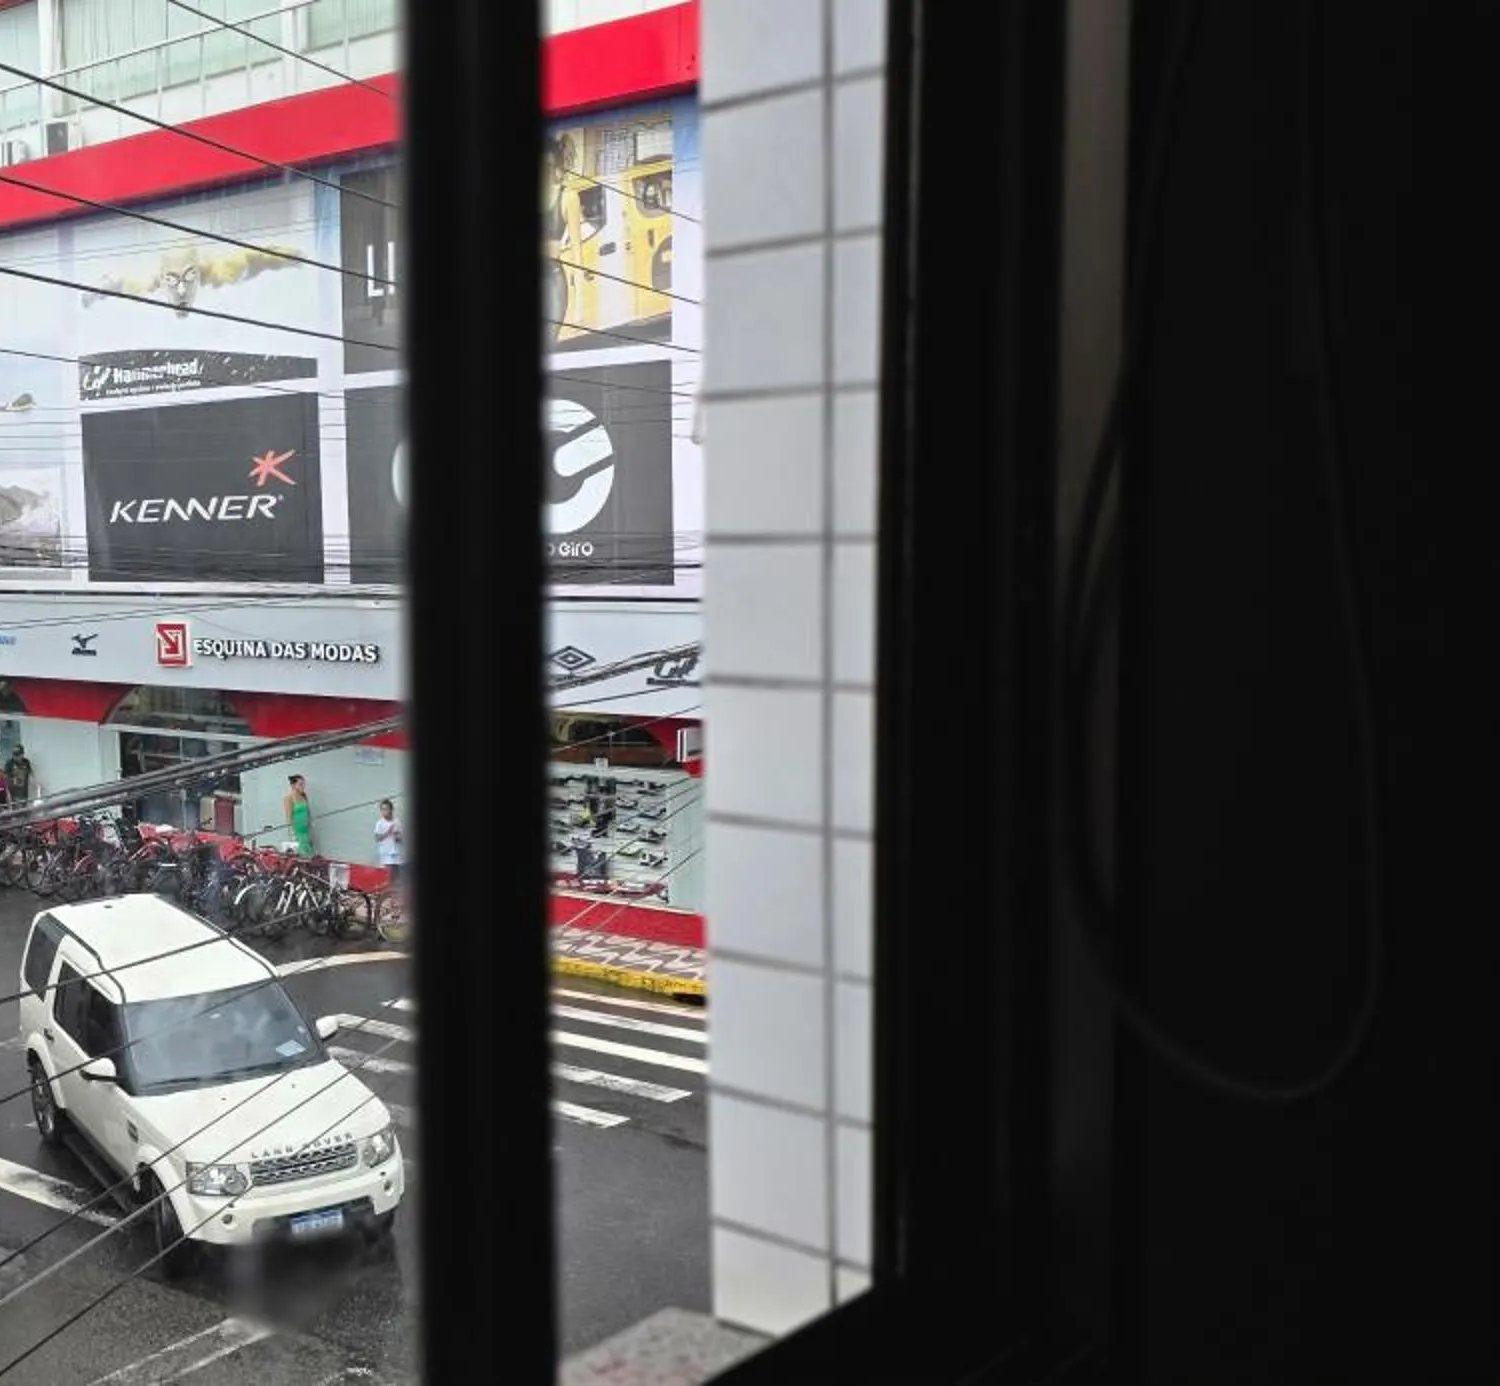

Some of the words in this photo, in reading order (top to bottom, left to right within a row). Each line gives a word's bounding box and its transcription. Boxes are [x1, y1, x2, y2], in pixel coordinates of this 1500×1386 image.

[109, 494, 277, 523] KENNER
[194, 640, 268, 660] ESQUINA
[271, 643, 306, 660] DAS
[311, 643, 381, 664] MODAS
